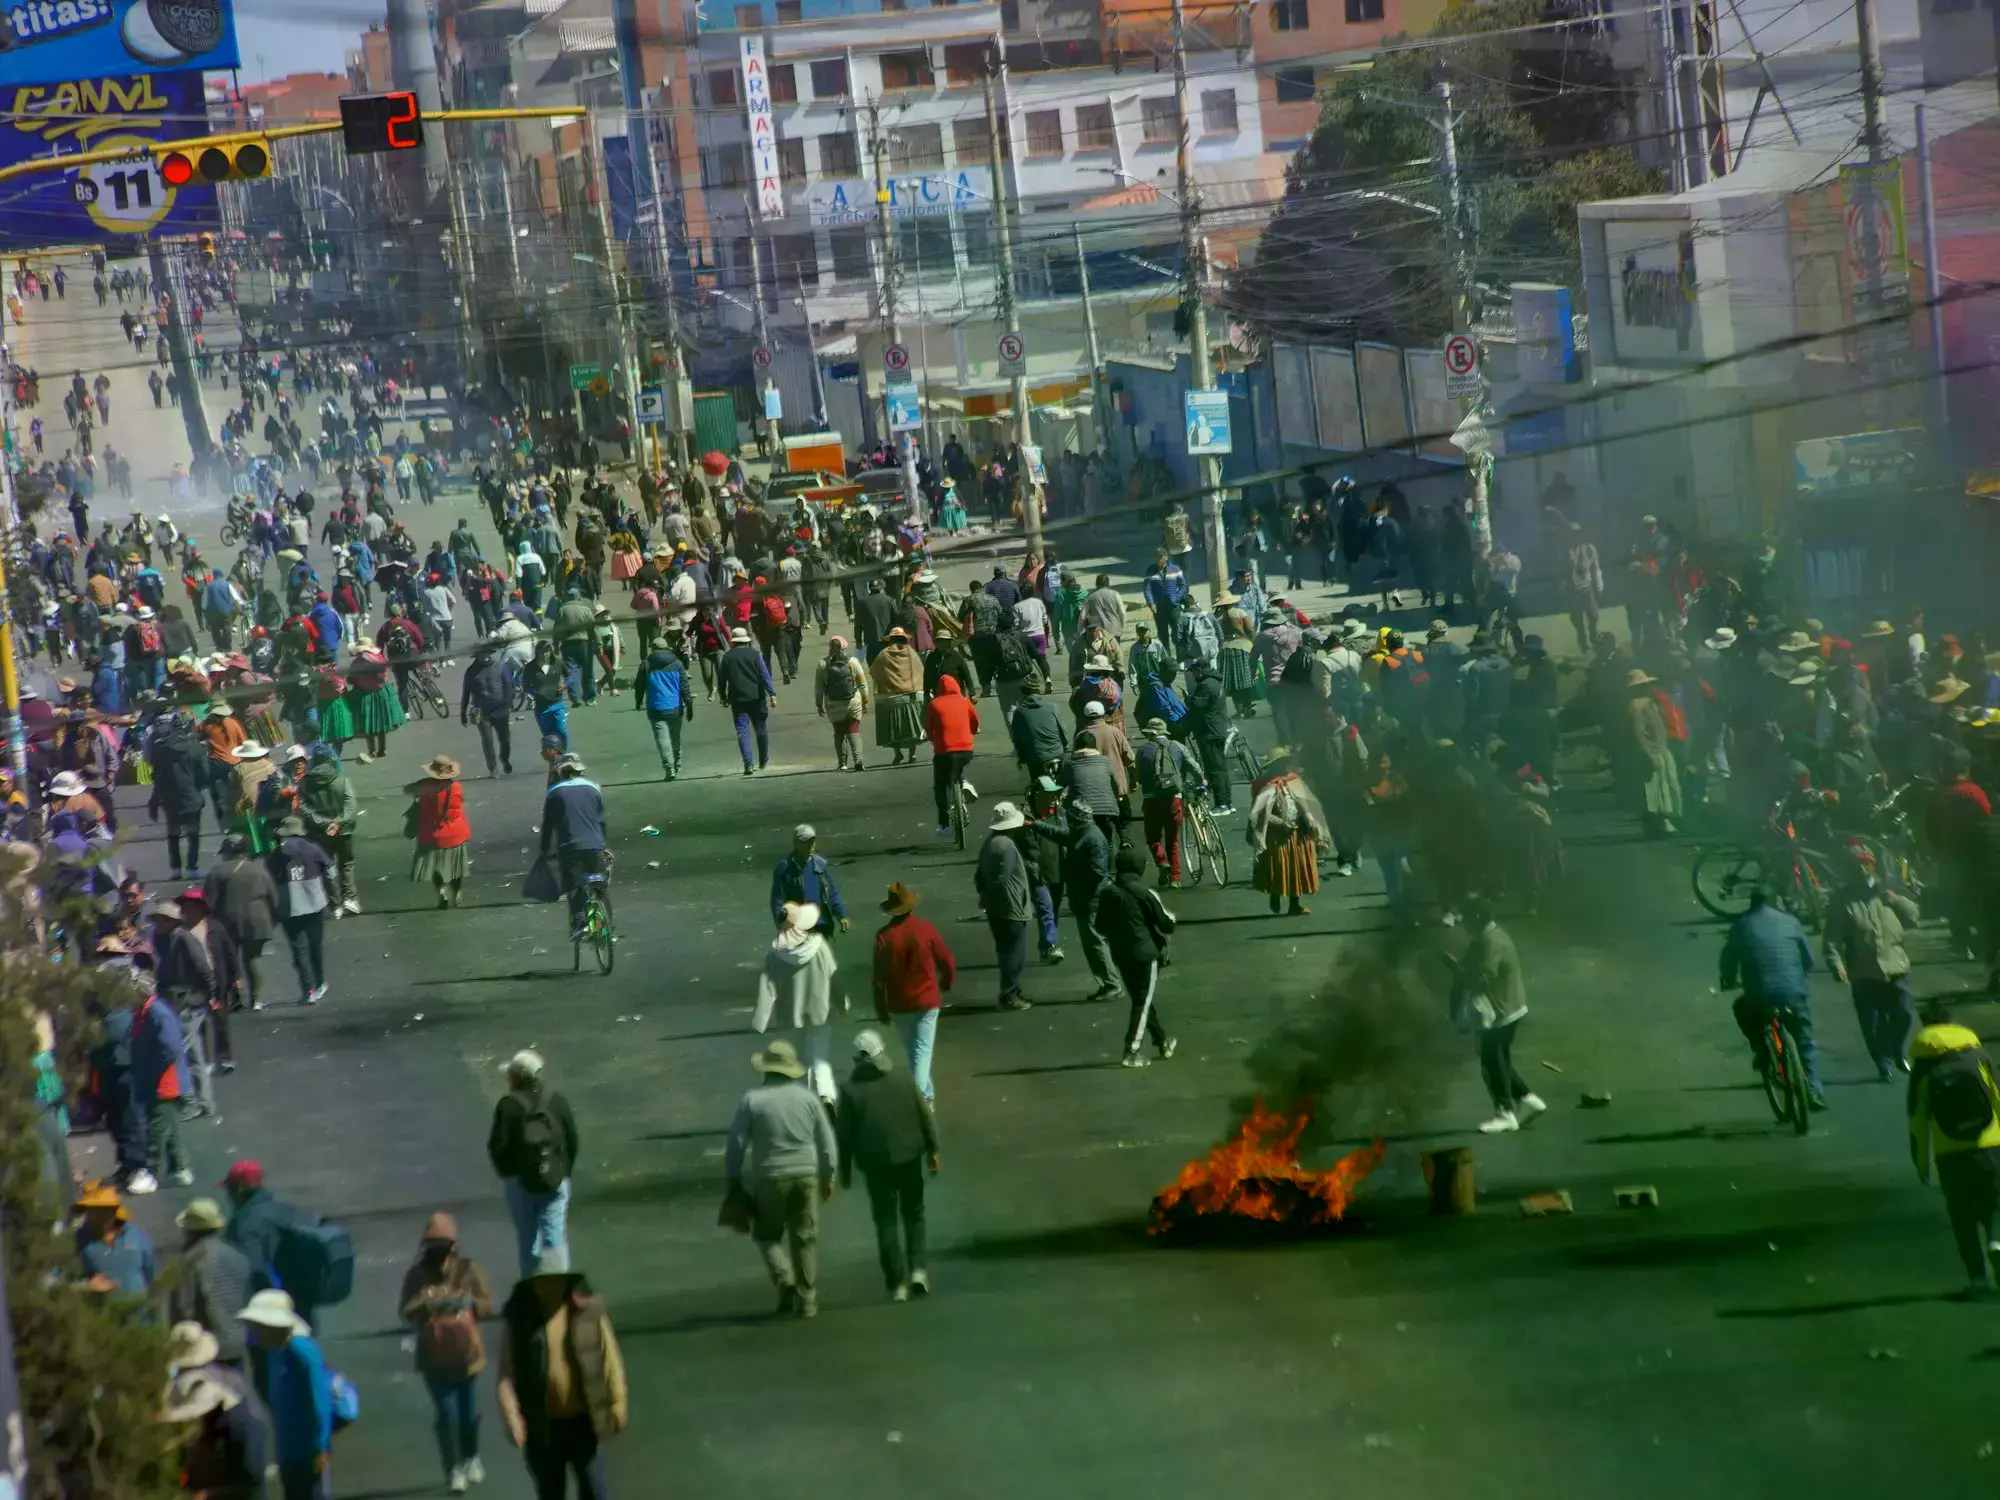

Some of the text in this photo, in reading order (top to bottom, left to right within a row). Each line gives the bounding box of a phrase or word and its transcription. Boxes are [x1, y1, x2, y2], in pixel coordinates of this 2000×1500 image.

[5, 0, 108, 37] titas
[386, 92, 417, 149] 2
[74, 169, 151, 210] Bs 11
[642, 397, 657, 412] P
